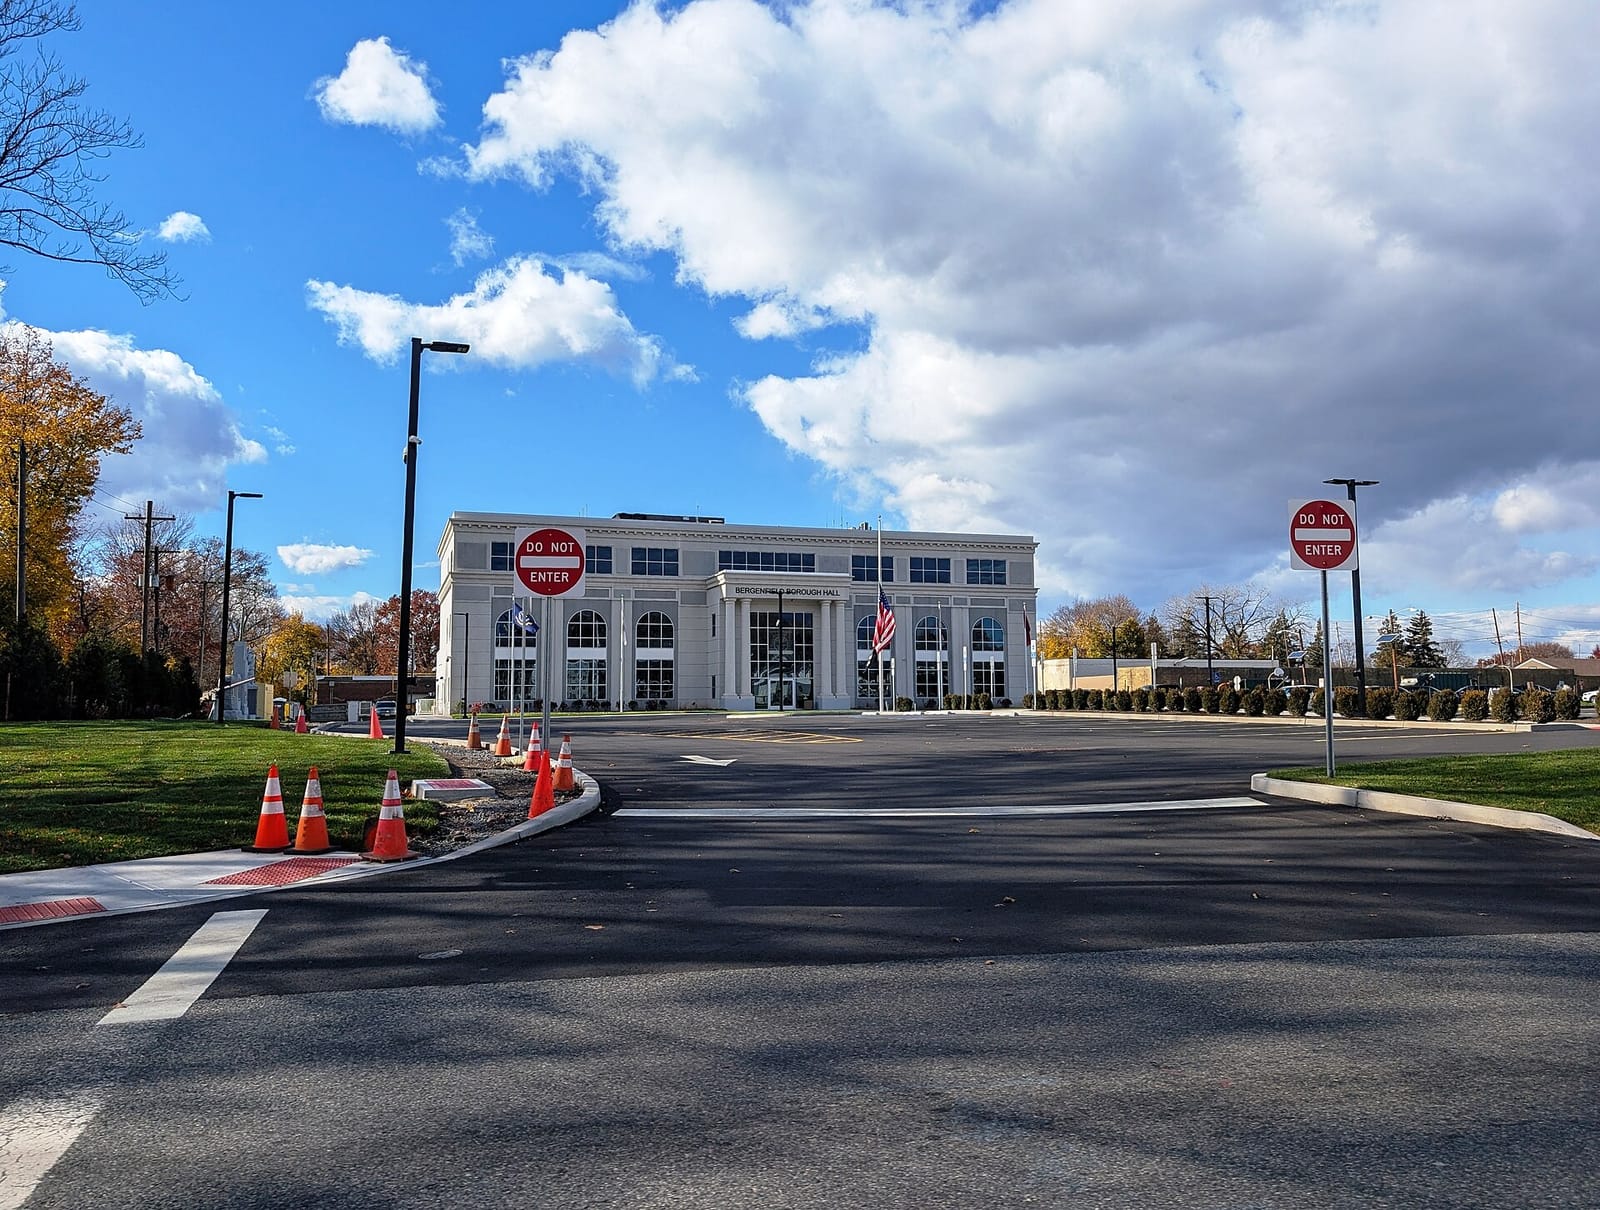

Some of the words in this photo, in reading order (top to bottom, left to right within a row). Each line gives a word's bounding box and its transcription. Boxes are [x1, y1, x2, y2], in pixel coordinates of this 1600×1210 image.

[1300, 514, 1315, 526] DO
[1322, 514, 1345, 526] NOT
[526, 542, 543, 552] DO
[551, 542, 575, 553] NOT
[1305, 544, 1342, 556] ENTER
[530, 572, 569, 583] ENTER
[786, 588, 821, 596] BOROUGH
[823, 589, 841, 597] HALL
